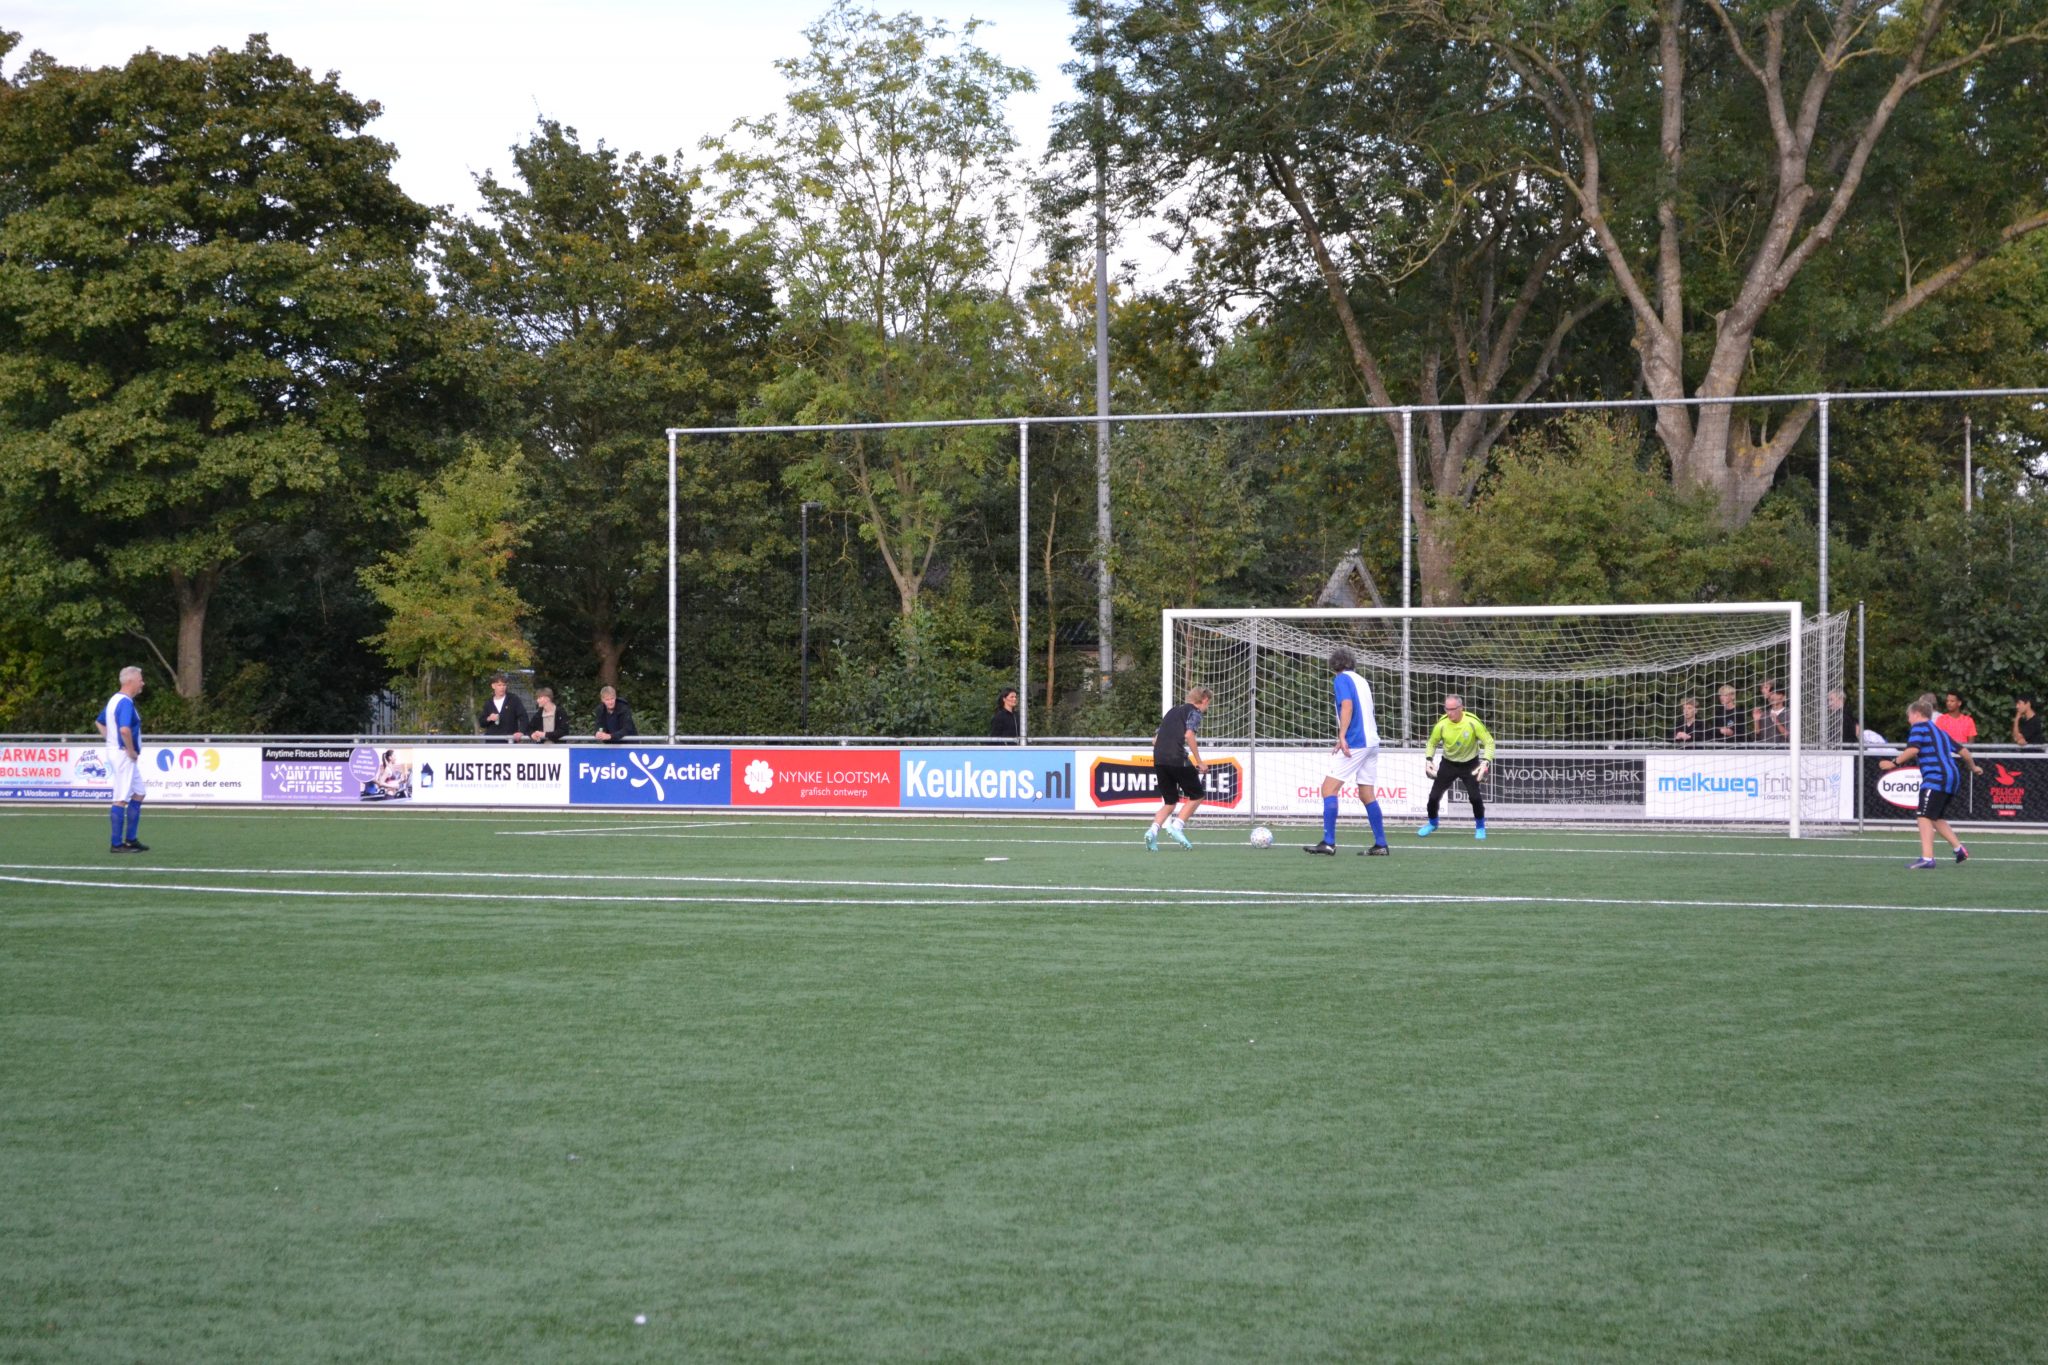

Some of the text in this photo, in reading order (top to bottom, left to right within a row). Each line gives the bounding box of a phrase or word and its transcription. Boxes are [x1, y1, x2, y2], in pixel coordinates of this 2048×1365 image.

[0, 748, 69, 762] ARWASH
[266, 749, 349, 758] Anytime Fitness Bolsward
[0, 767, 61, 777] BOLSWARD
[286, 766, 342, 780] ANYTIME
[445, 763, 561, 781] KUSTERS BOUW
[579, 763, 720, 783] Fysio Actief
[779, 771, 890, 784] NYNKE LOOTSMA
[1503, 769, 1641, 781] WOONHUYS DIRK
[165, 781, 182, 789] groep
[203, 780, 216, 788] der
[906, 760, 1071, 800] Keukens.nl
[1100, 771, 1230, 793] JUMPLE
[1658, 772, 1759, 797] melkweg
[286, 781, 342, 793] FITNESS
[801, 787, 868, 798] grafisch ontwerp
[1883, 781, 1920, 793] brand
[71, 790, 113, 799] Stofzuigers
